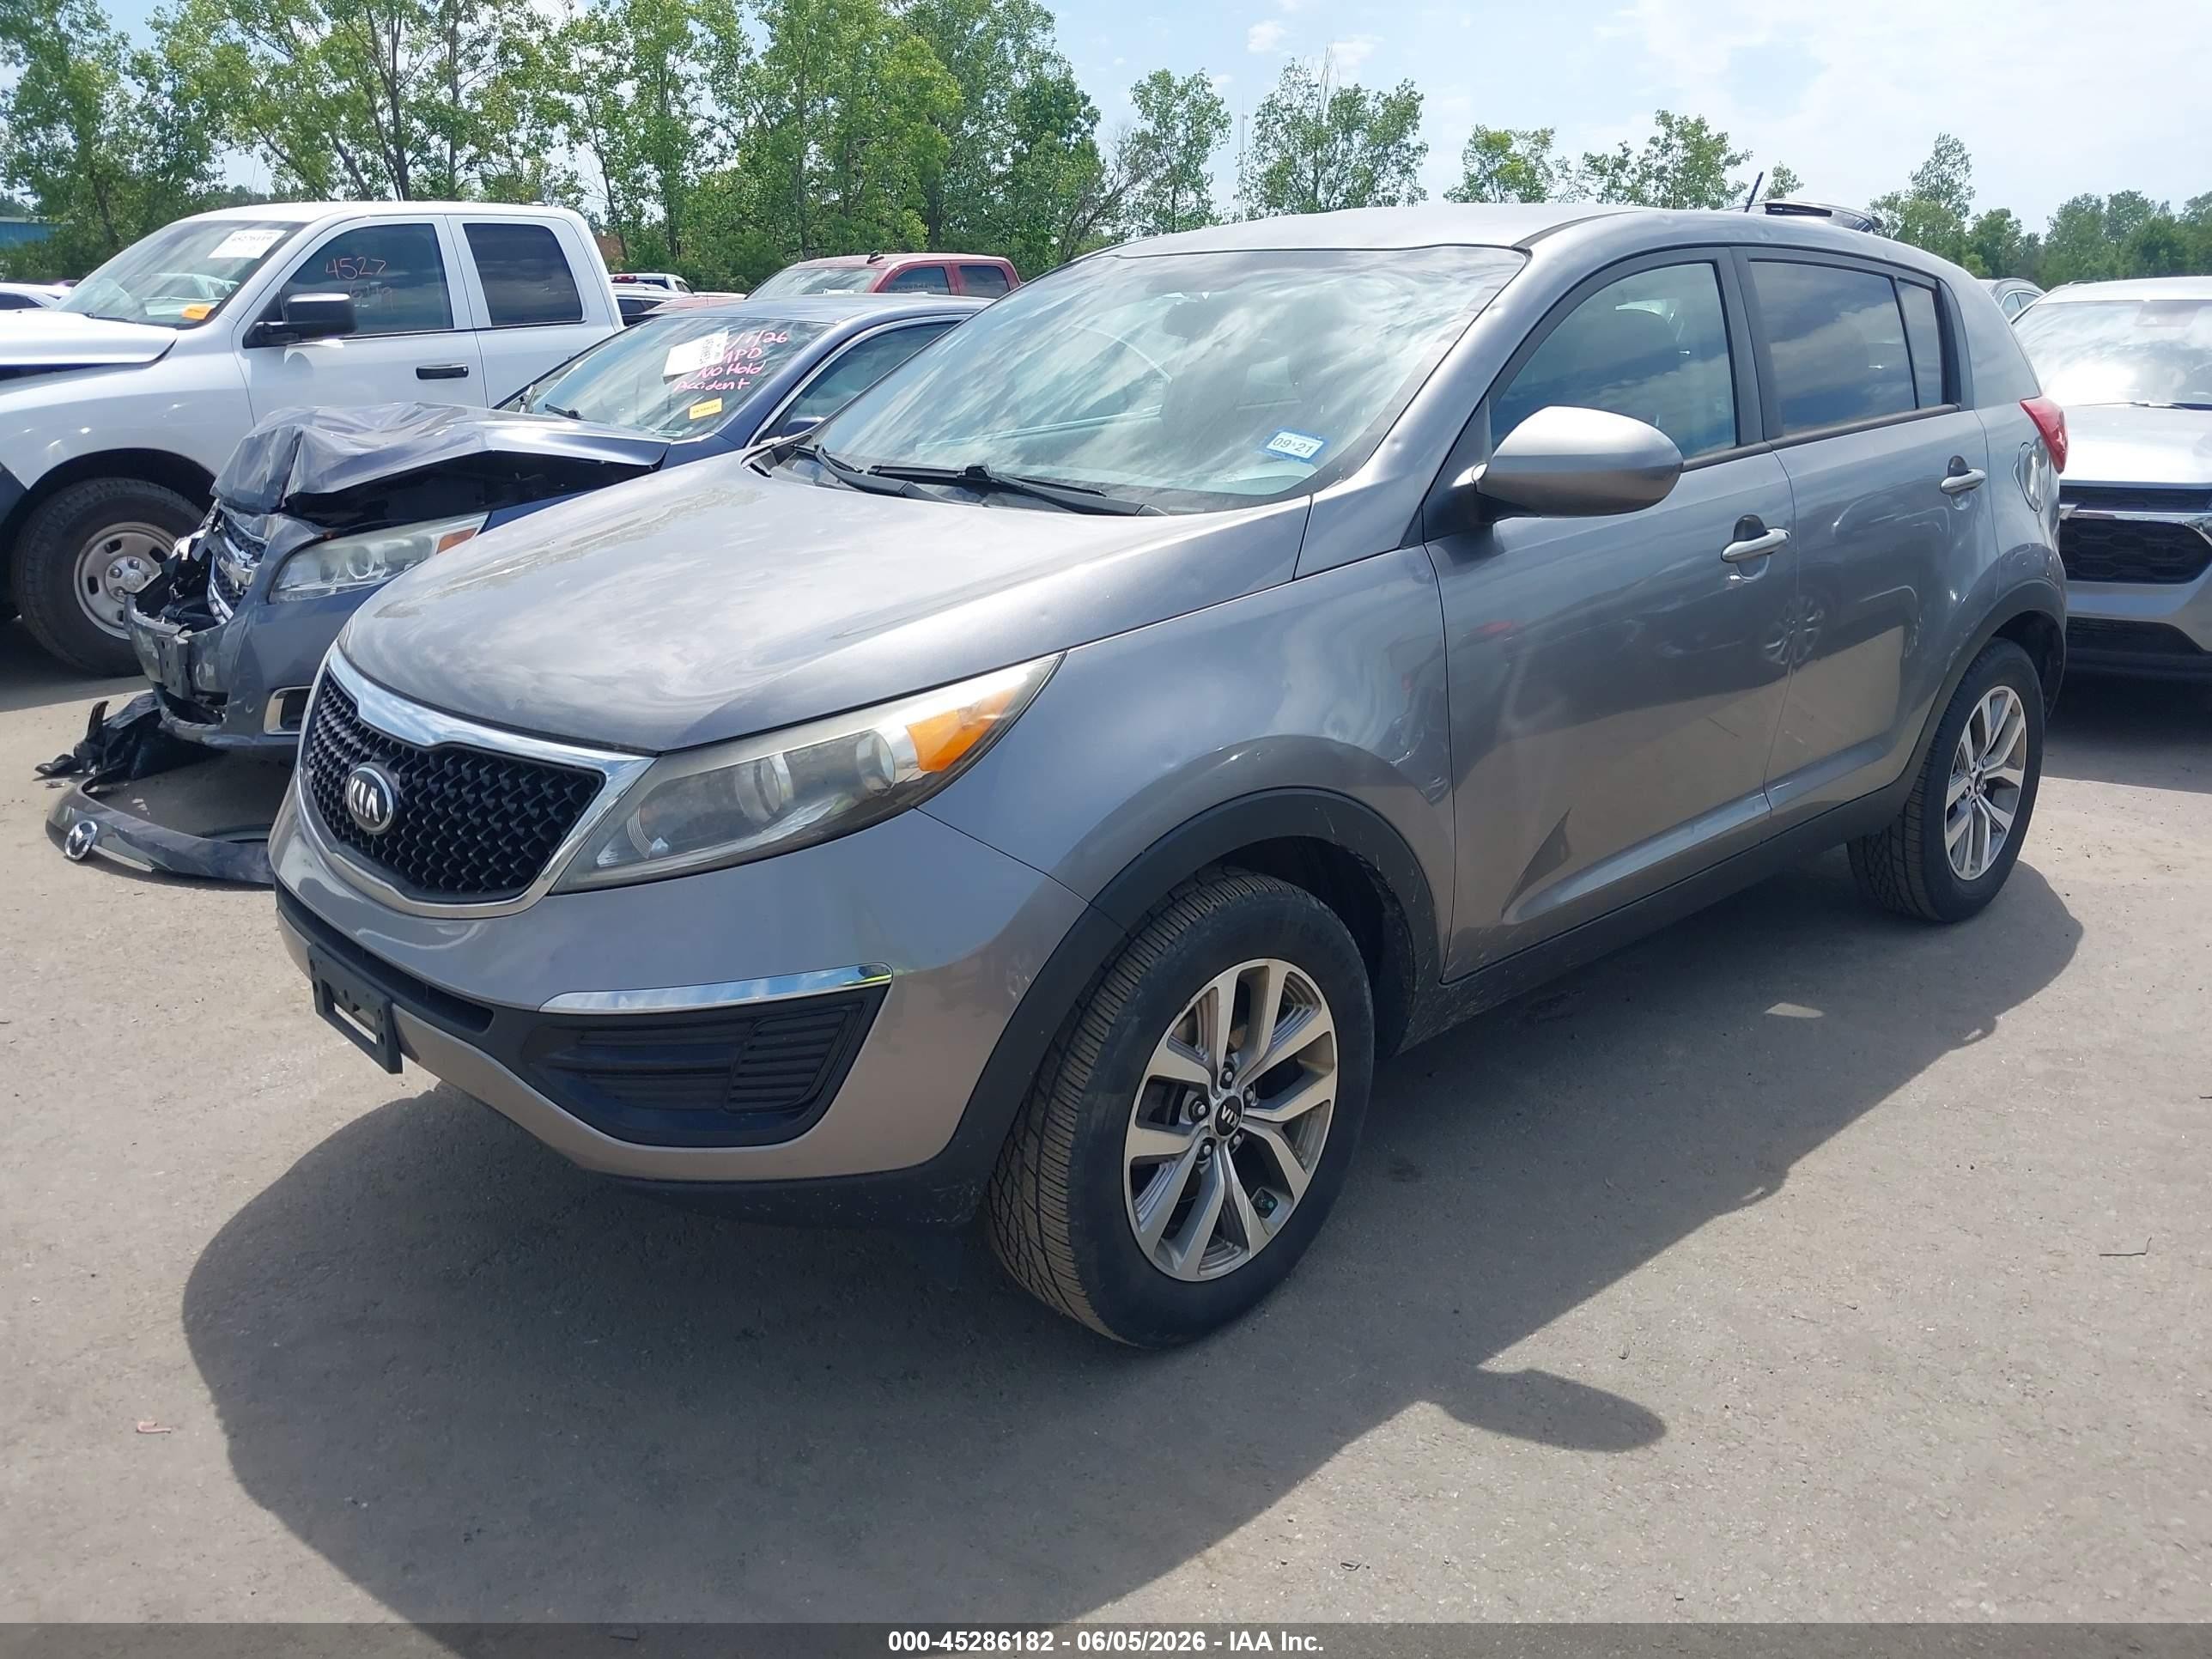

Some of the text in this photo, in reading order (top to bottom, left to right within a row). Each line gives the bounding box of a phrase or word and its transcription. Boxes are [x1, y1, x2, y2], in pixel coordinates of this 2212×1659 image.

[325, 256, 386, 280] 4527
[726, 359, 767, 376] Hold
[672, 378, 750, 392] Accident
[1273, 437, 1292, 448] 09
[1294, 442, 1314, 454] 21
[349, 775, 380, 823] KIA
[1221, 1104, 1240, 1128] KIA
